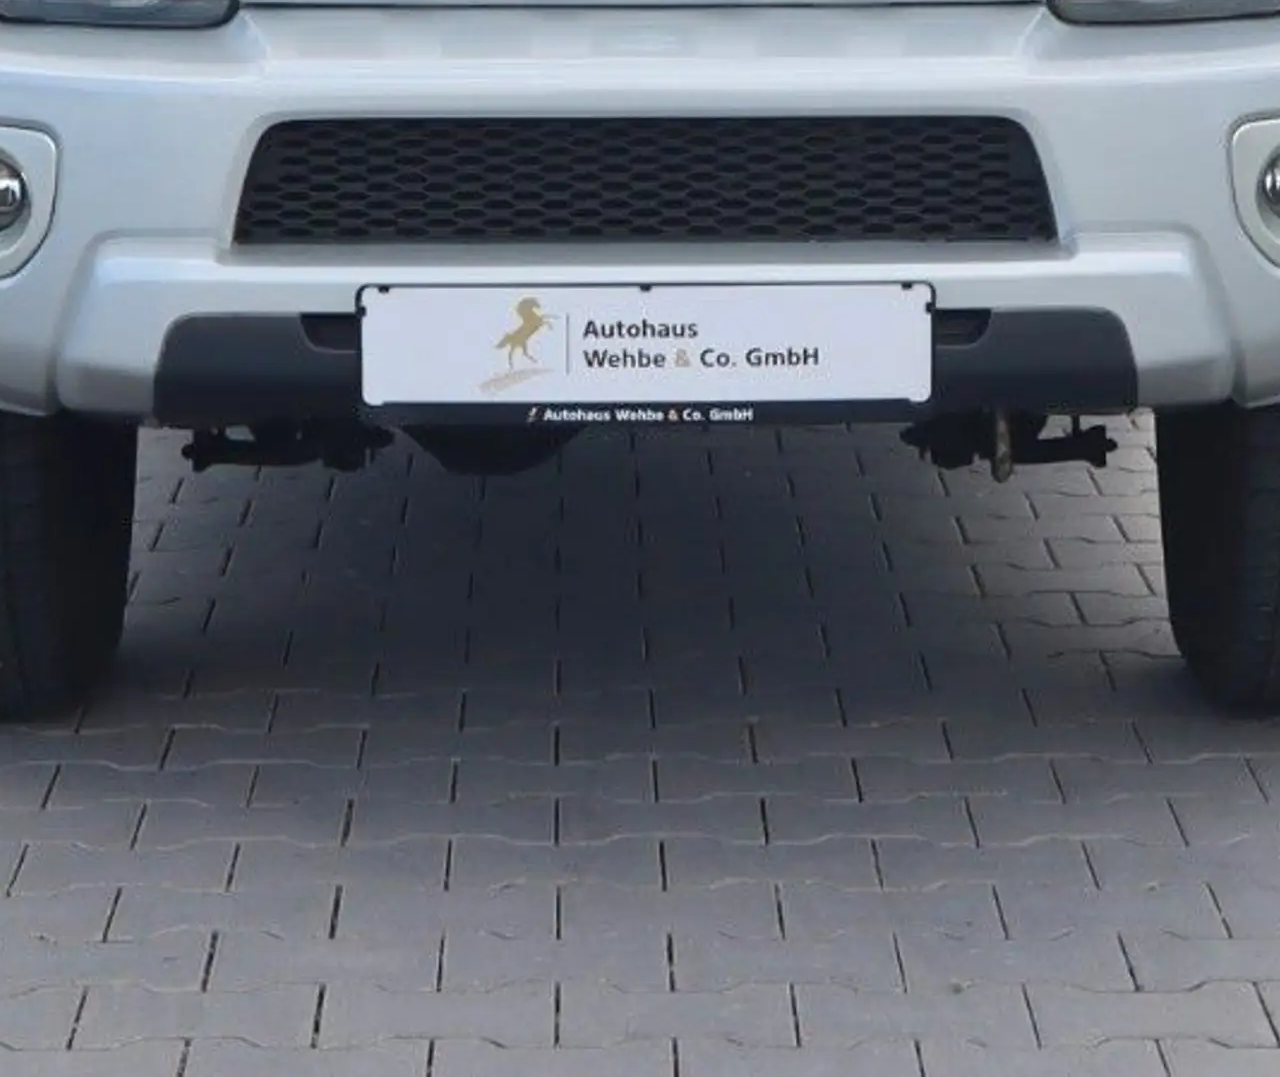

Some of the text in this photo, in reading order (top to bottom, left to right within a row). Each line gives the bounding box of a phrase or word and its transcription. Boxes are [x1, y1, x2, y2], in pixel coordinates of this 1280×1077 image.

[582, 318, 699, 339] Autohaus
[582, 347, 820, 368] Wehbe & Co. GmbH
[543, 407, 754, 421] Autohaus Wehbe & Co. GmbH
